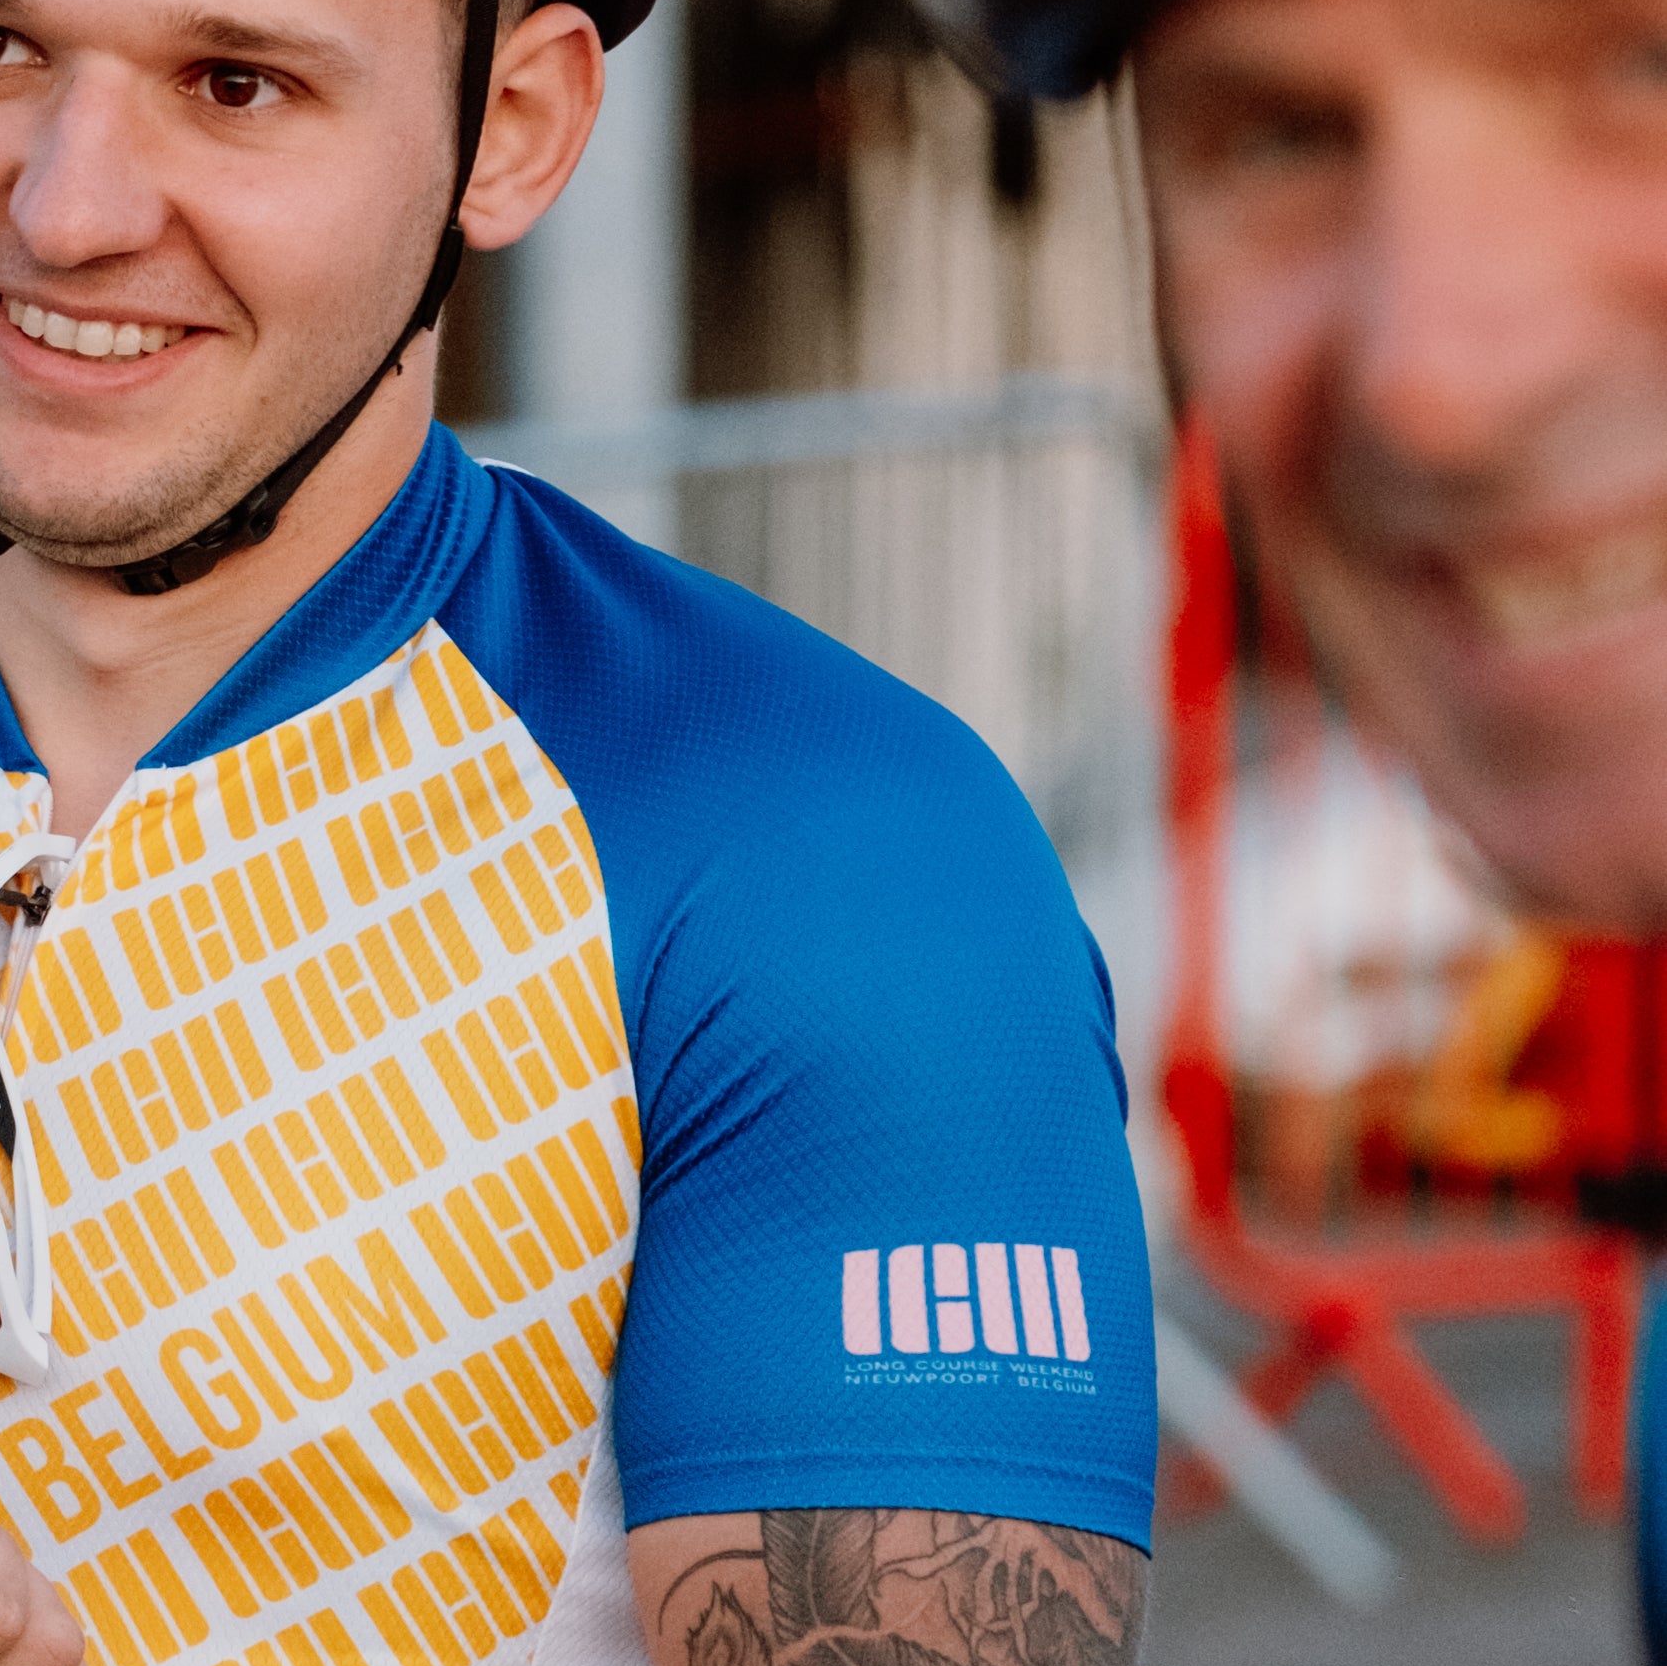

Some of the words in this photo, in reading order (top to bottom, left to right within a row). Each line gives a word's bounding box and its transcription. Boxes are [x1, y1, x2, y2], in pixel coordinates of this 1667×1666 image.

[844, 1360, 906, 1373] LONG
[915, 1360, 1001, 1372] COURSE
[1009, 1361, 1094, 1381] WEEKEND
[844, 1373, 1000, 1385] NIEUWPOORT
[1017, 1376, 1097, 1395] BELGIUM
